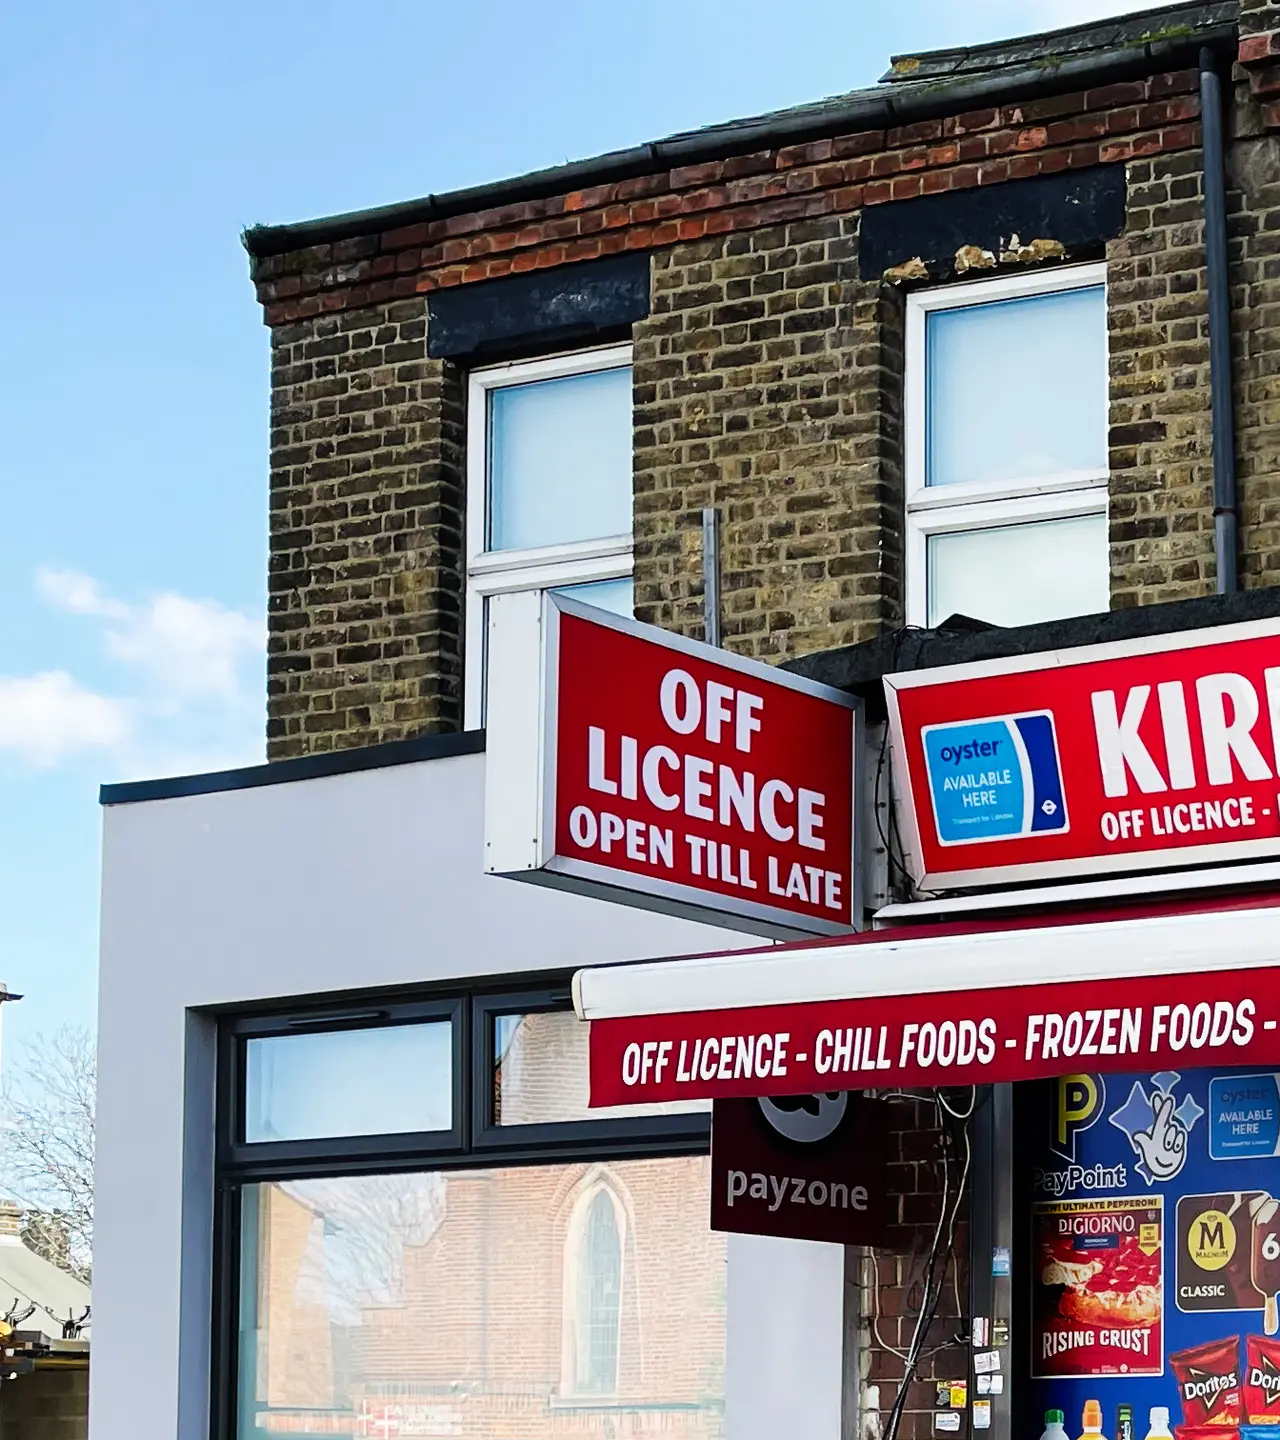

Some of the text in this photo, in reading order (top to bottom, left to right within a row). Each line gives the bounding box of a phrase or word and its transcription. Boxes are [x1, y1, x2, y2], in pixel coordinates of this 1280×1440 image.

[660, 669, 764, 753] OFF
[941, 739, 1003, 766] oyster
[588, 726, 826, 852] LICENCE
[943, 769, 1012, 792] AVAILABLE
[962, 790, 998, 808] HERE
[1100, 807, 1145, 841] OFF
[1151, 796, 1256, 835] LICENCE
[569, 805, 843, 911] OPEN TILL LATE
[622, 1039, 671, 1086] OFF
[676, 1032, 790, 1082] LICENCE
[813, 1024, 891, 1076] CHILL
[899, 1017, 997, 1068] FOODS
[1024, 1007, 1143, 1061] FROZEN
[1149, 999, 1256, 1051] FOODS
[1219, 1109, 1273, 1123] AVAILABLE
[1232, 1123, 1259, 1135] HERE
[727, 1169, 868, 1212] payzone
[1180, 1284, 1225, 1298] CLASSIC
[1042, 1329, 1151, 1360] RISING CRUST
[1185, 1372, 1237, 1400] Doritos
